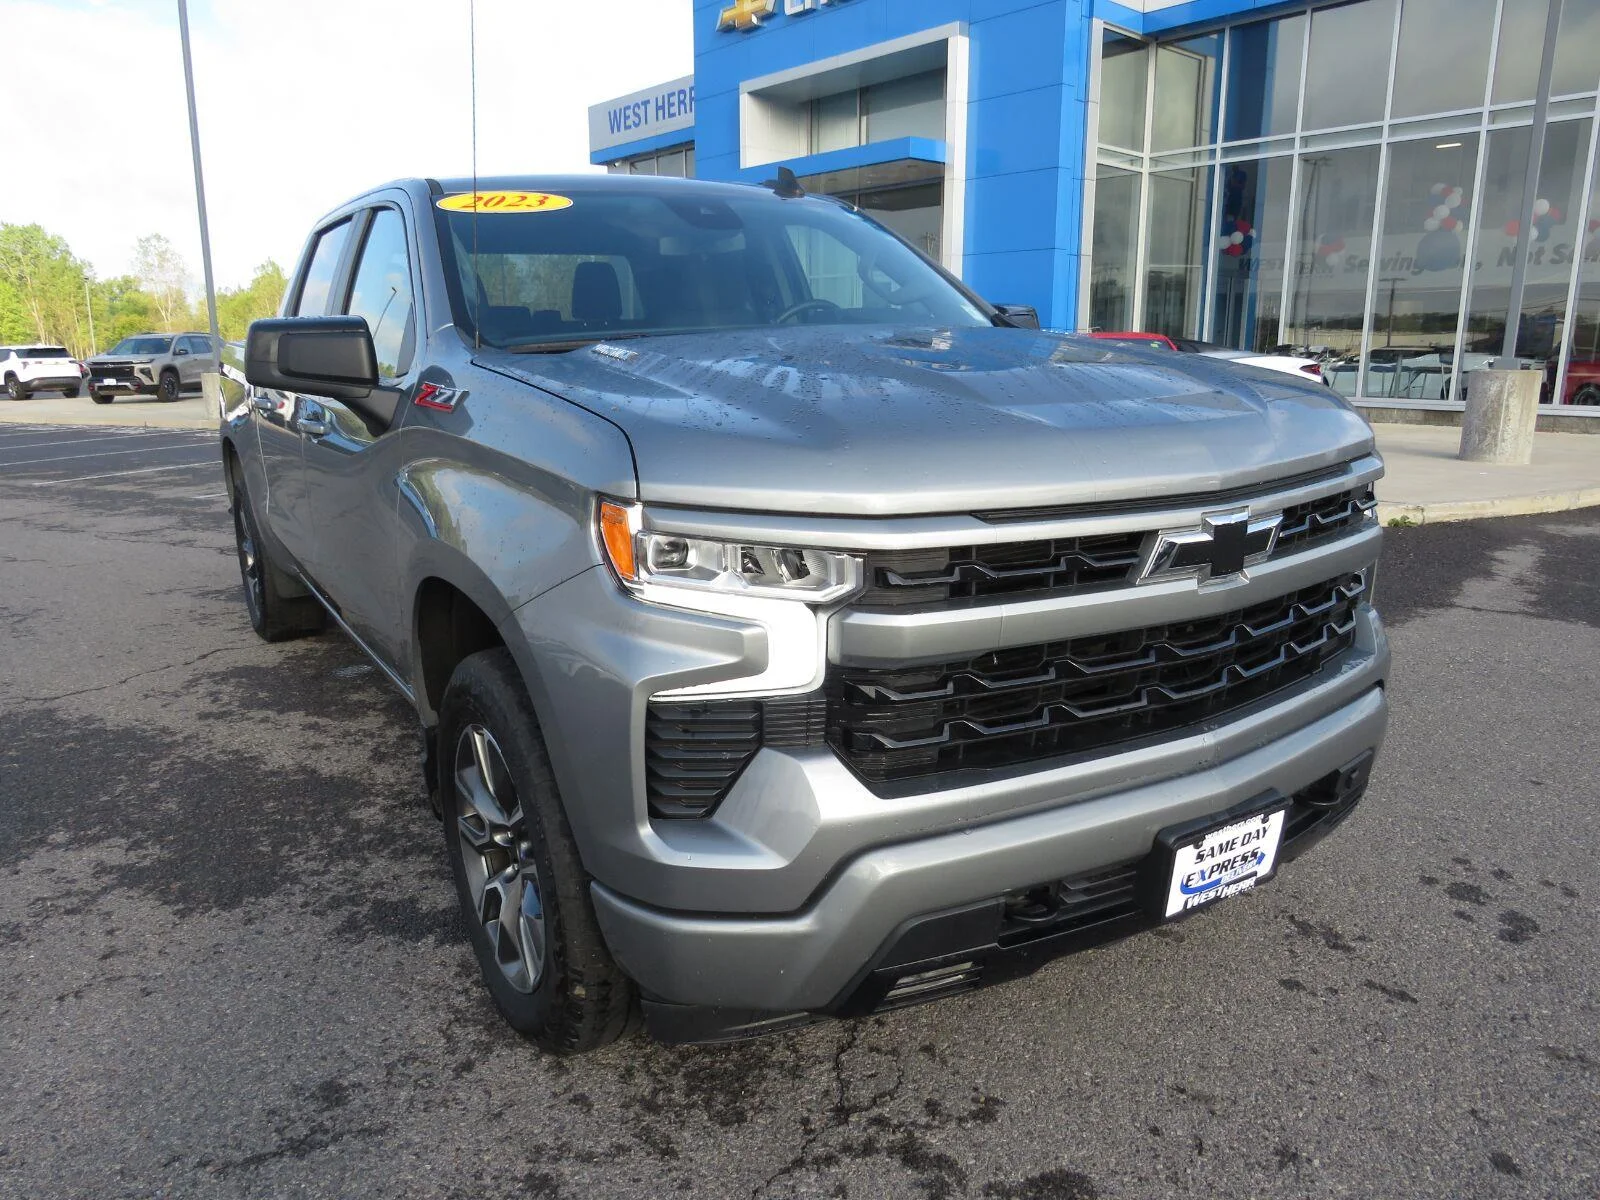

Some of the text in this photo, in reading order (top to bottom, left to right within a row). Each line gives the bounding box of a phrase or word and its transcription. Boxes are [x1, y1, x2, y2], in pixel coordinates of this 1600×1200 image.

[608, 99, 650, 134] WEST
[459, 195, 549, 209] 2023
[1194, 823, 1272, 866] SAME DAY
[1184, 846, 1261, 888] EXPRESS
